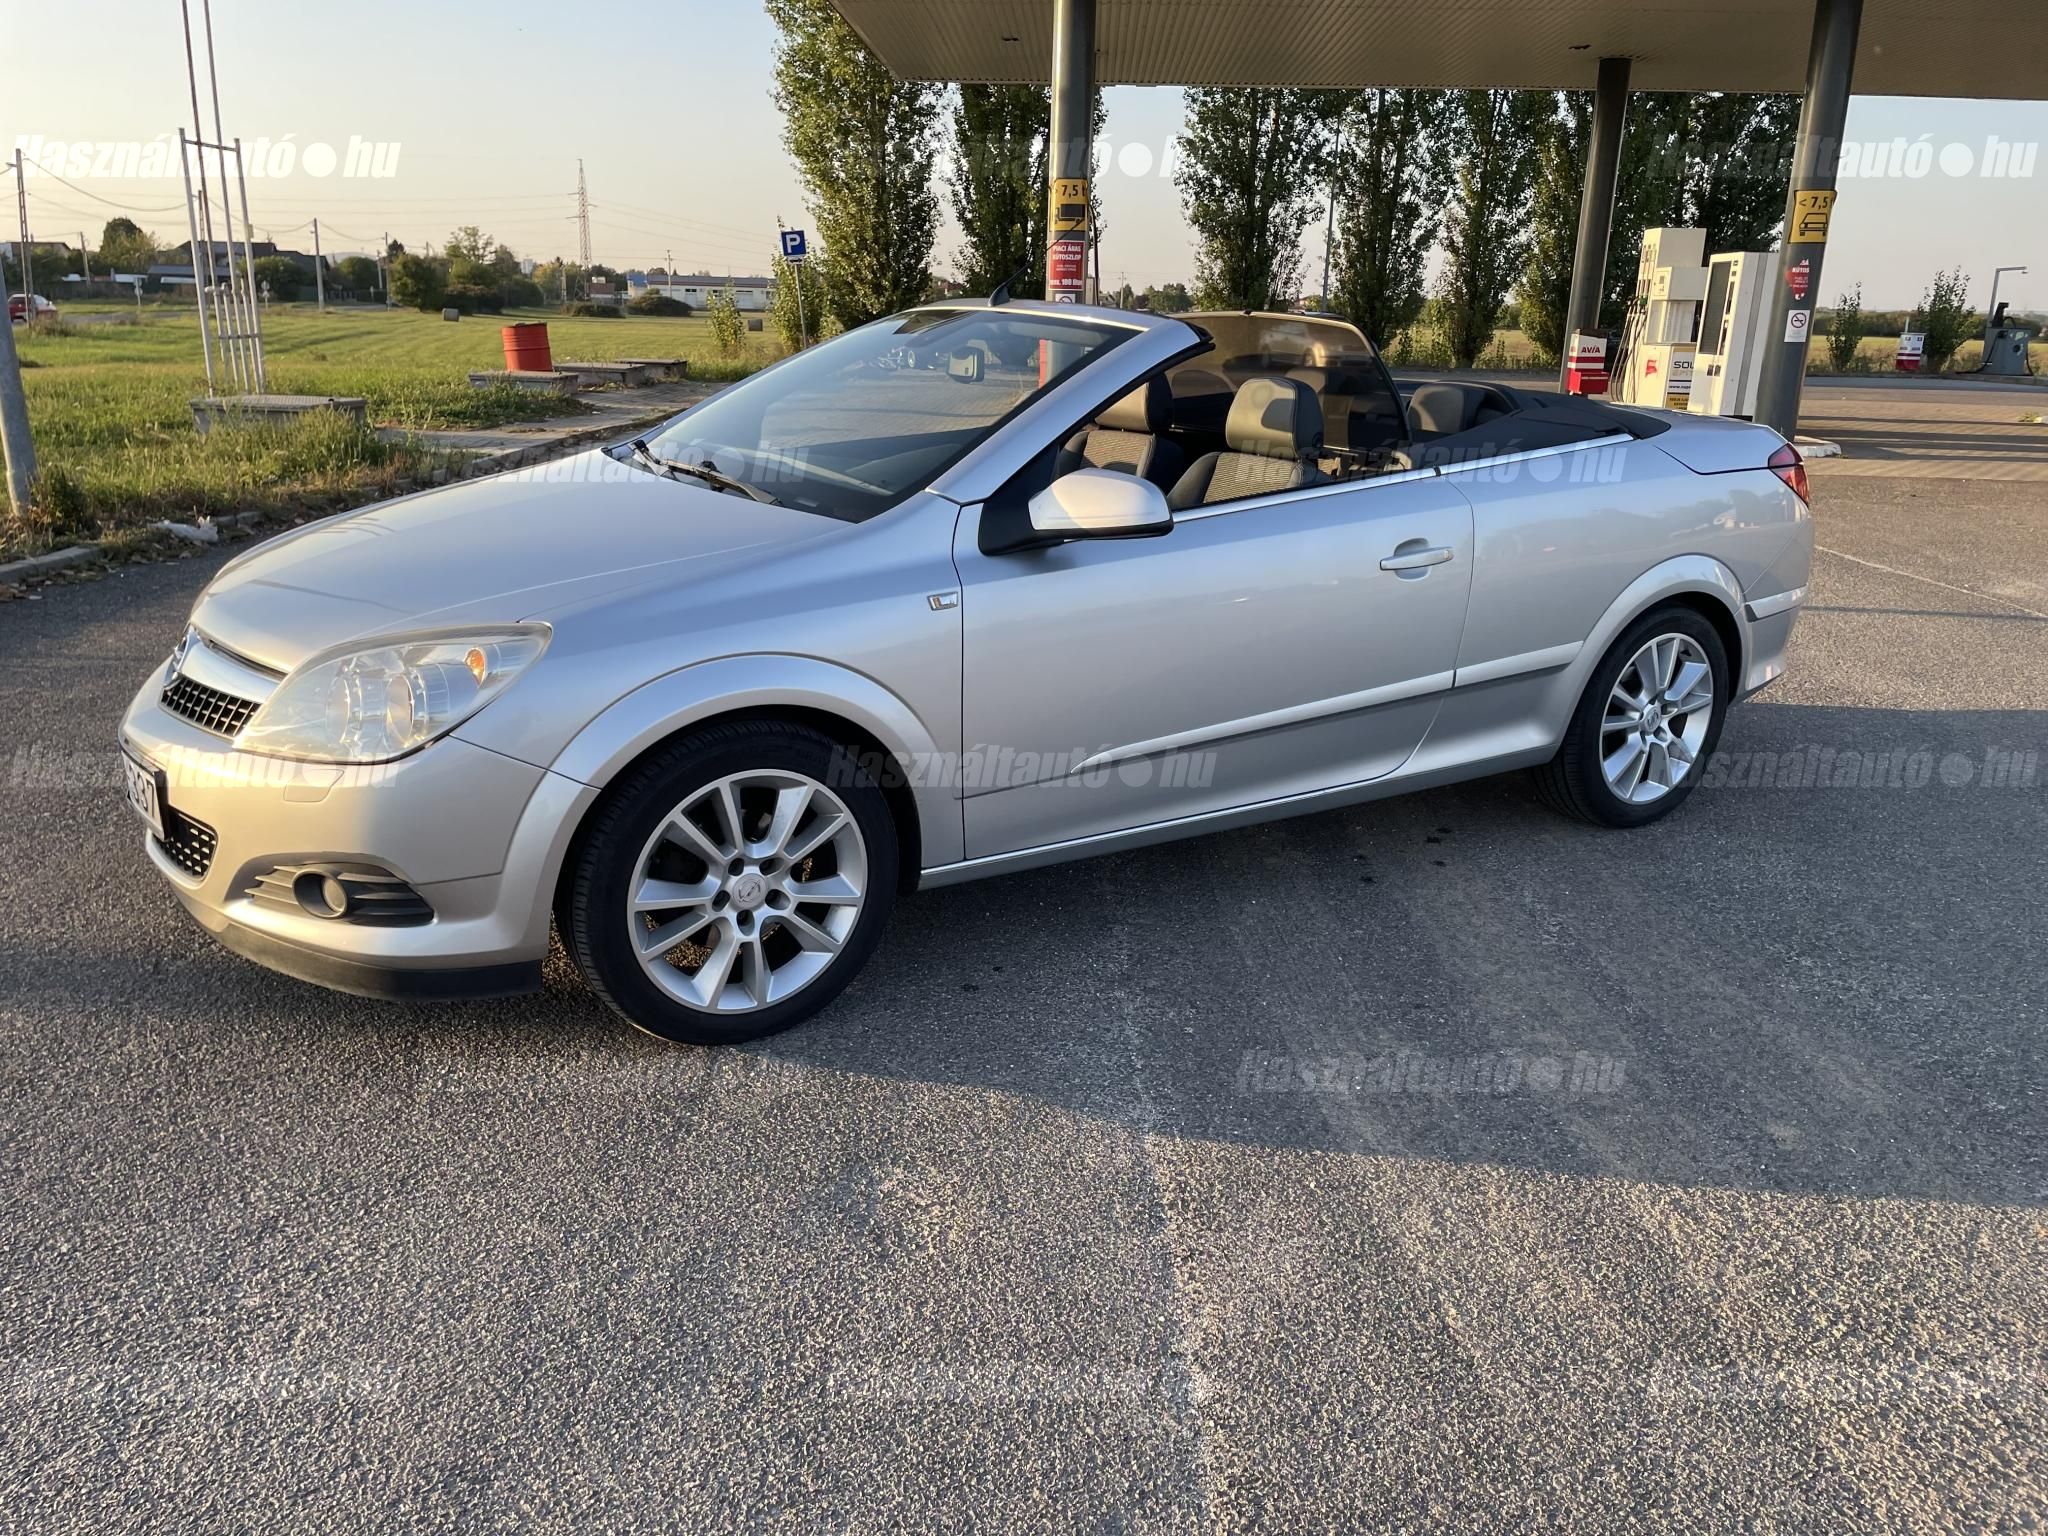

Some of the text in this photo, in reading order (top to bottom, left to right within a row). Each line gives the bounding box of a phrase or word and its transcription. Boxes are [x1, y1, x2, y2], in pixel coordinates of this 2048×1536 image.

[1061, 184, 1079, 199] 7,5
[1810, 196, 1829, 210] 7,5
[785, 233, 801, 254] P
[1581, 346, 1601, 354] AVIA
